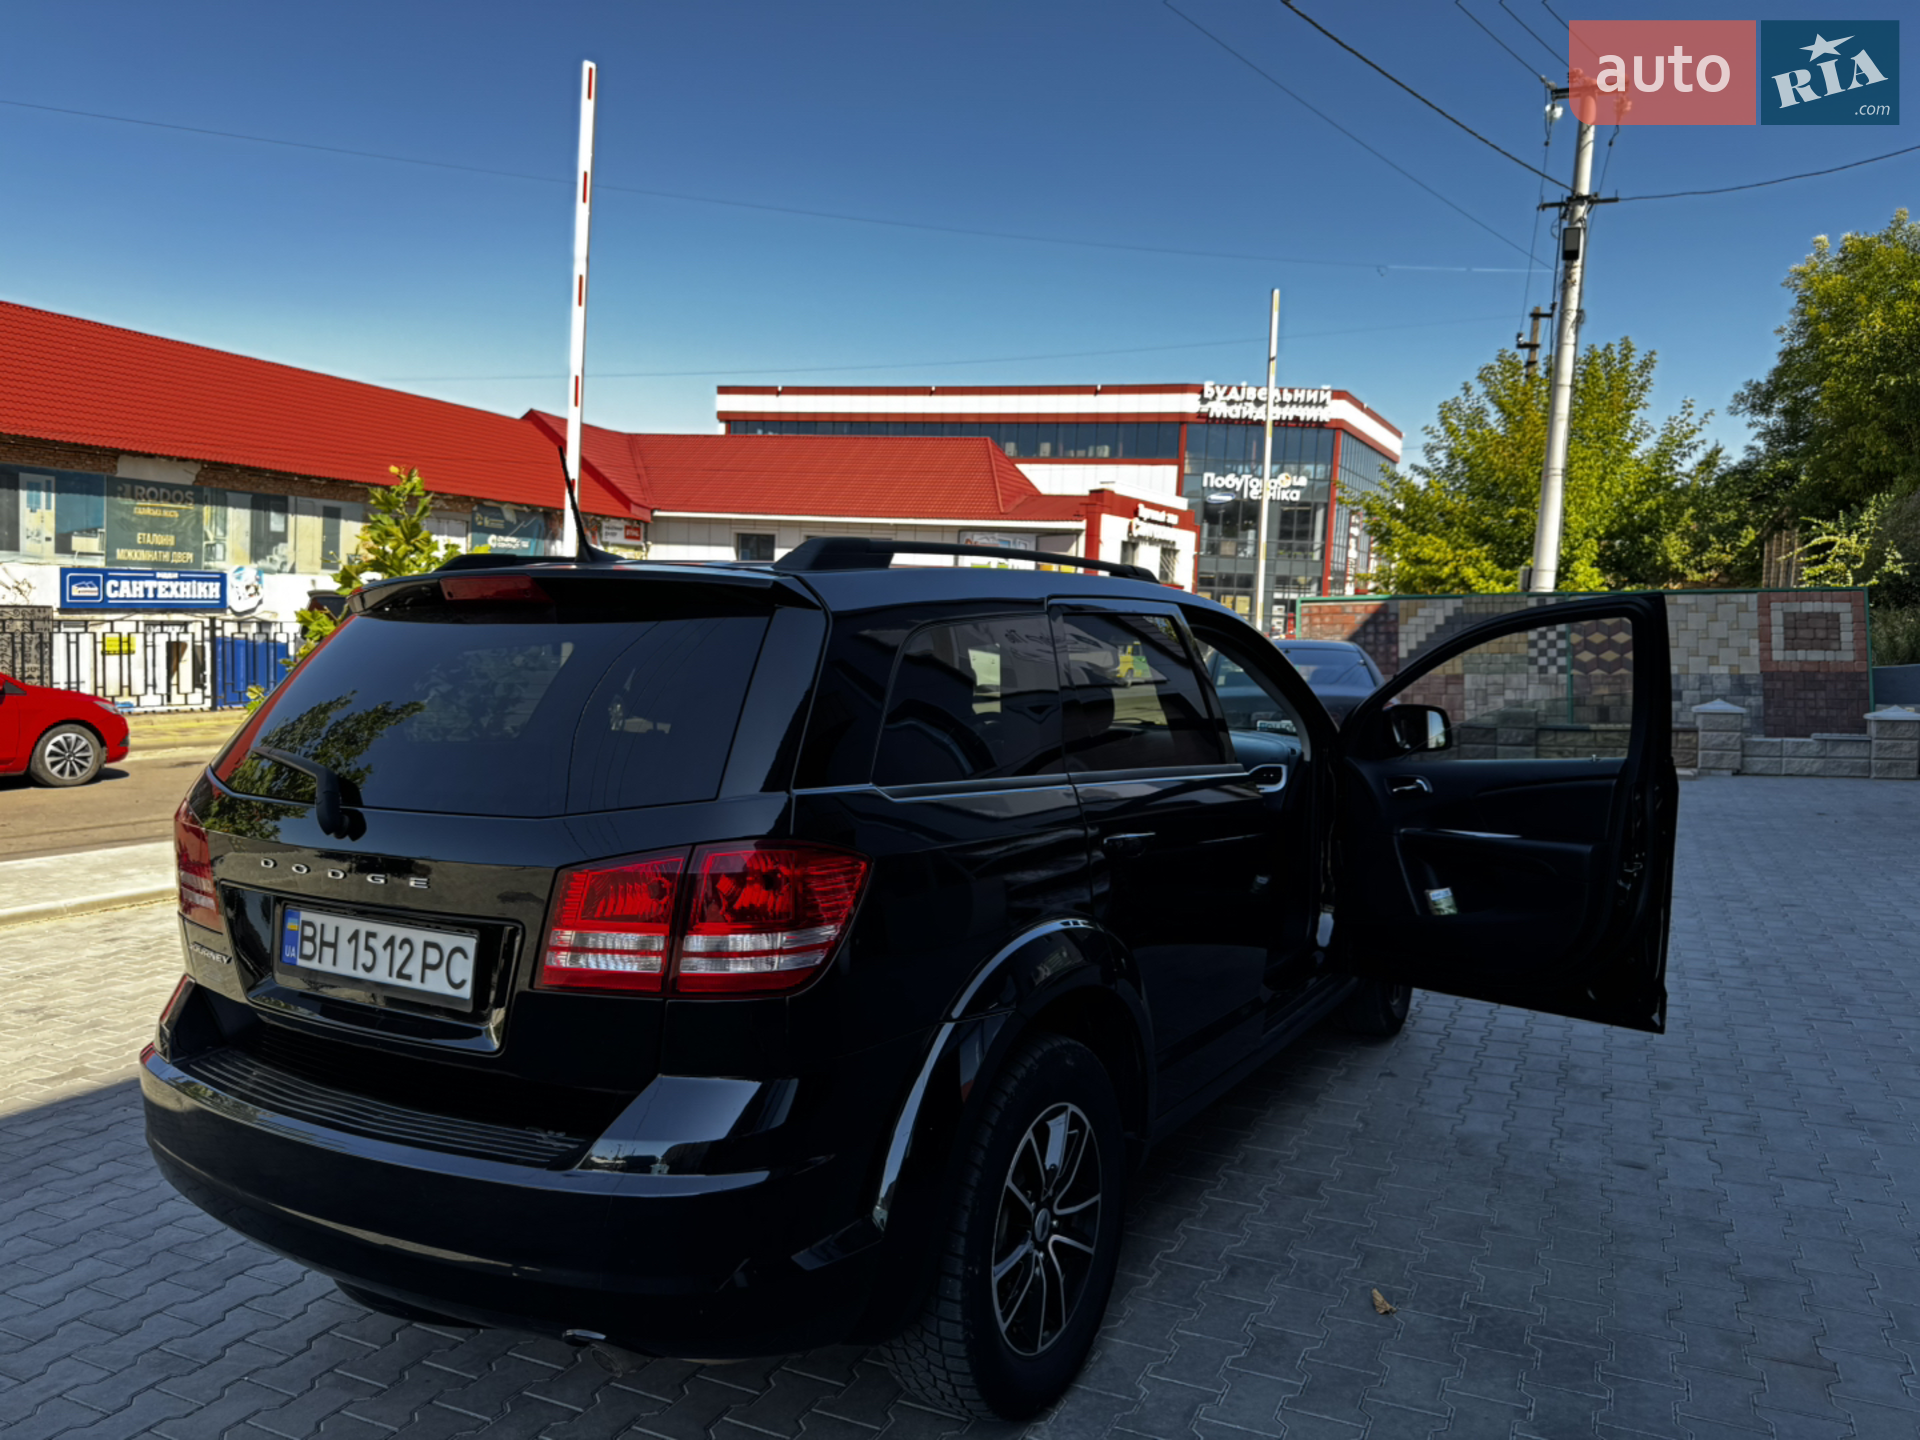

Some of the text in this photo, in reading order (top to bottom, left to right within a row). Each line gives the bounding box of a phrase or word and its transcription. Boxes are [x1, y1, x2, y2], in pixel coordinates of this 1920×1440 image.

[134, 485, 195, 504] RODOS
[260, 858, 431, 890] DODGE
[285, 946, 297, 959] UA
